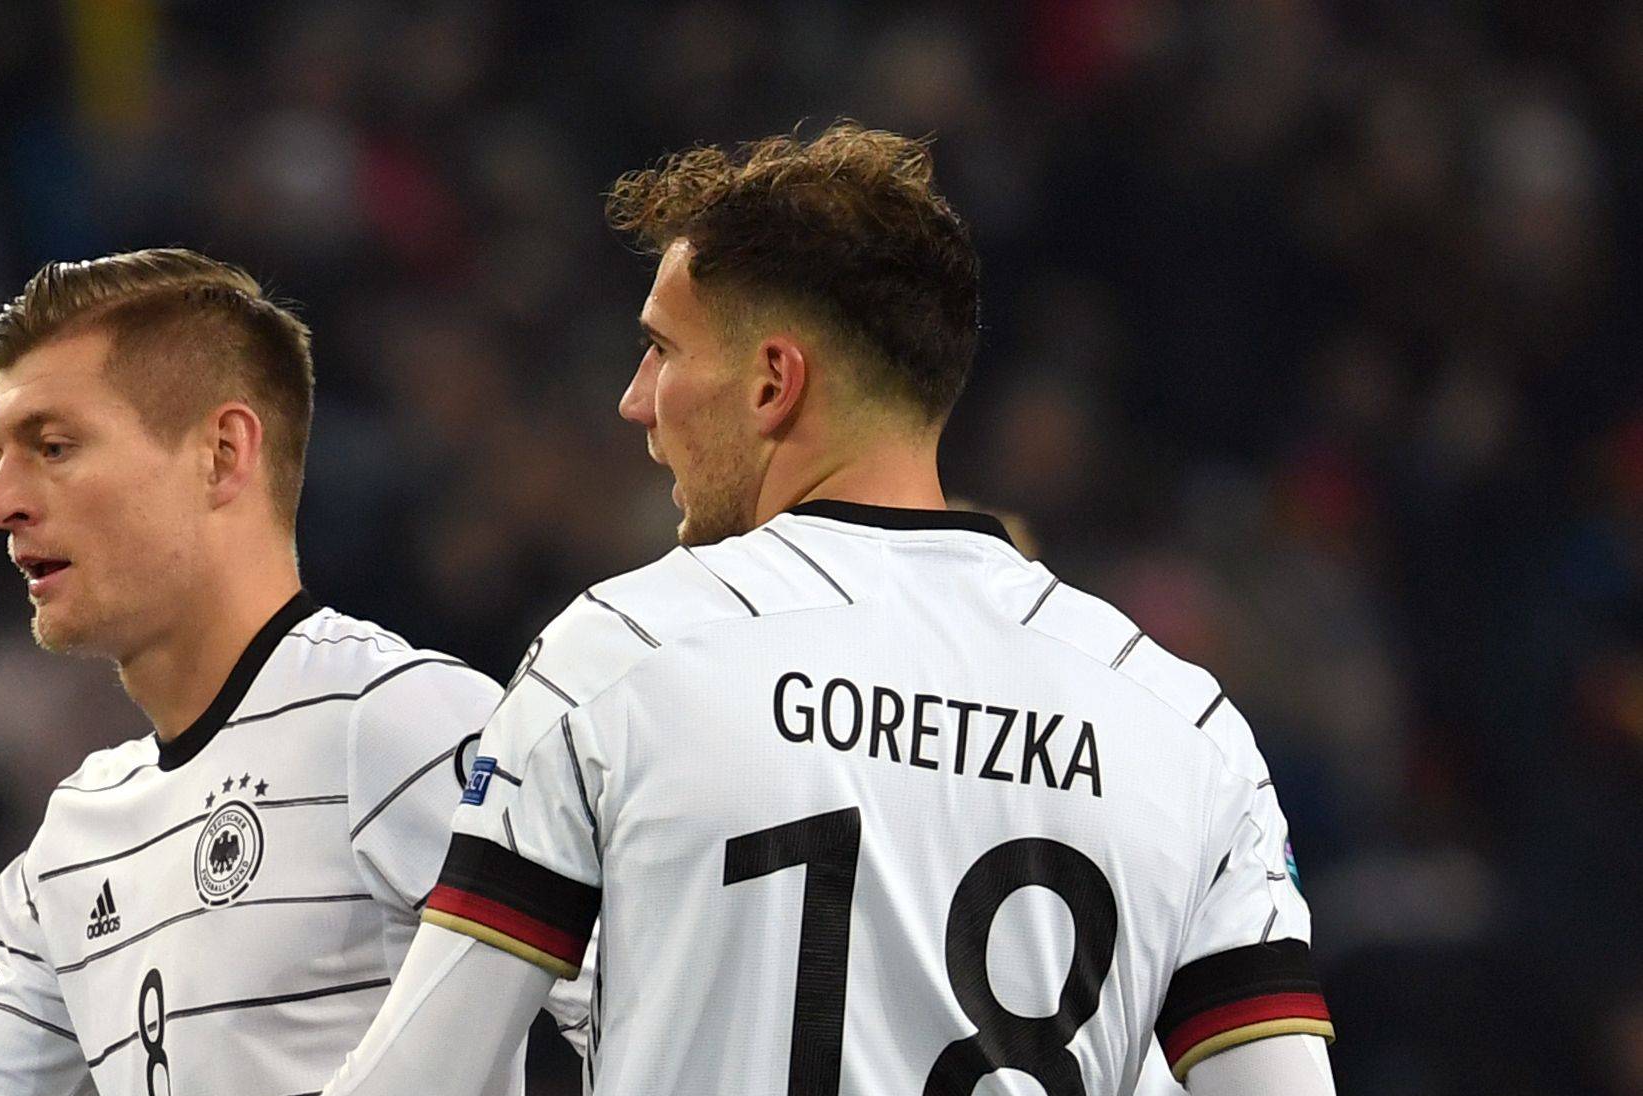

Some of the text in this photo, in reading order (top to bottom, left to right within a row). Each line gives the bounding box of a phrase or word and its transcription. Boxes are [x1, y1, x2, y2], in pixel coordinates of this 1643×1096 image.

[772, 671, 1103, 798] GORETZKA
[208, 813, 247, 838] DEUTSCHER
[87, 914, 121, 940] adidas
